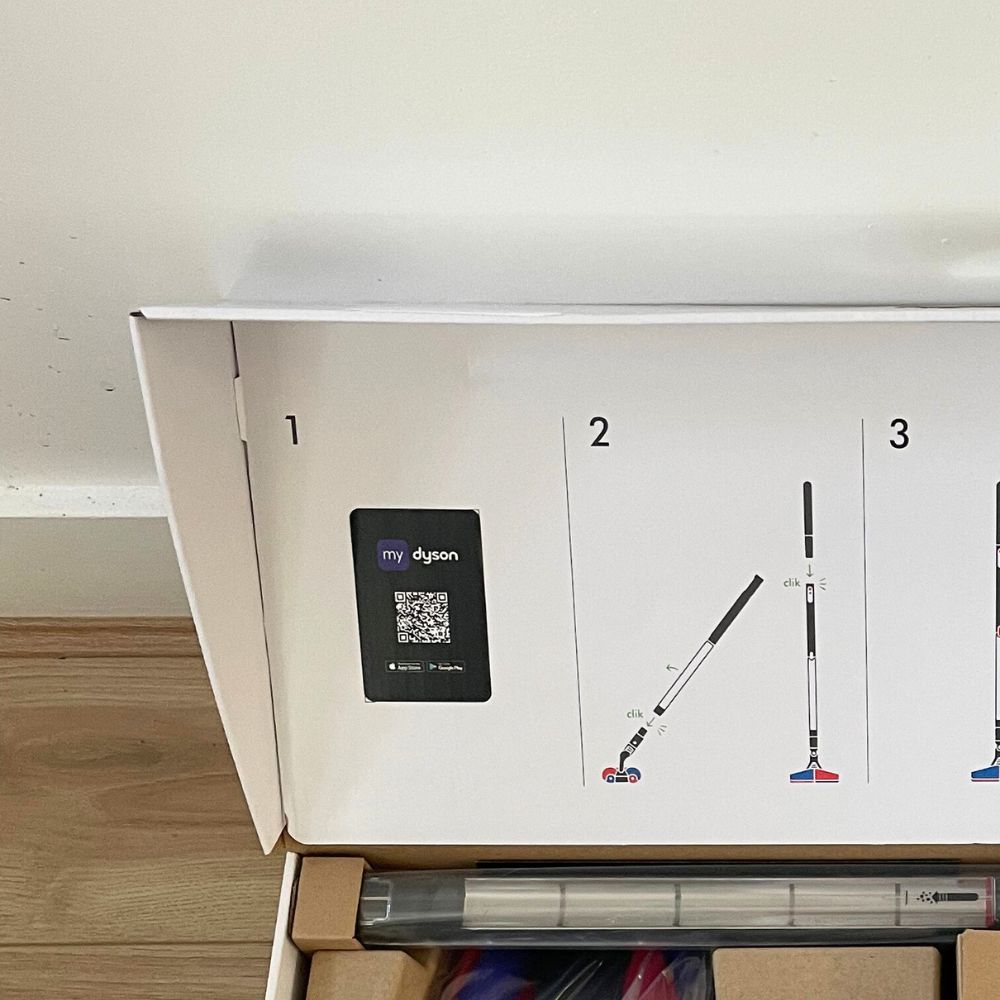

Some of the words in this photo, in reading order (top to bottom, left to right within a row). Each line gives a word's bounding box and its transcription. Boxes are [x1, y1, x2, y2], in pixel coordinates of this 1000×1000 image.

[284, 416, 298, 444] 1
[590, 416, 610, 446] 2
[890, 418, 909, 449] 3
[382, 550, 404, 564] my
[412, 546, 458, 564] dyson
[783, 578, 800, 588] clik
[626, 709, 644, 719] clik
